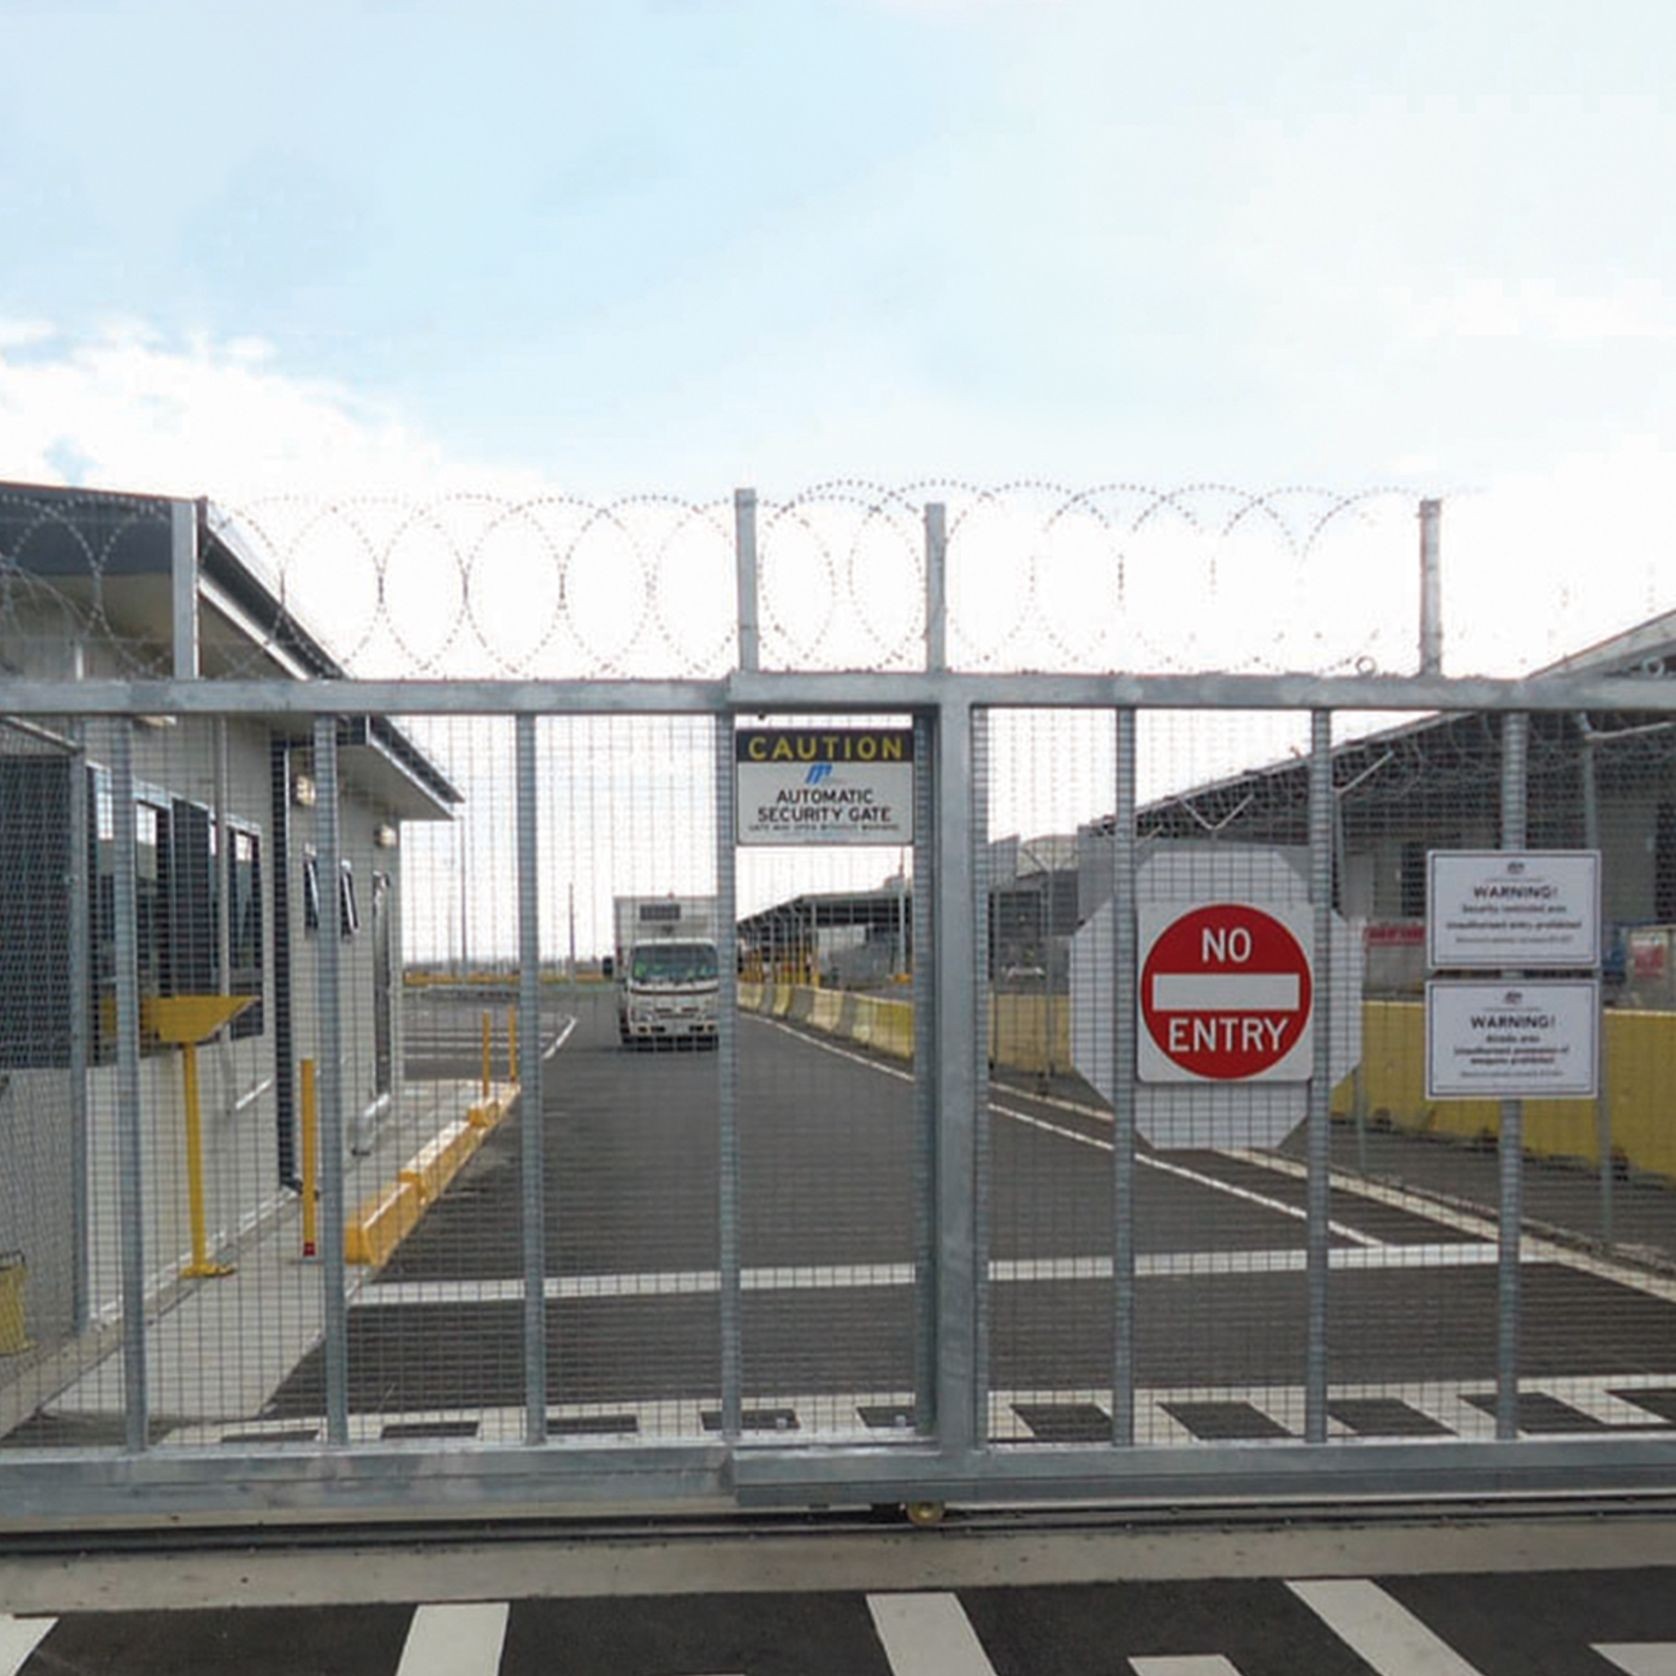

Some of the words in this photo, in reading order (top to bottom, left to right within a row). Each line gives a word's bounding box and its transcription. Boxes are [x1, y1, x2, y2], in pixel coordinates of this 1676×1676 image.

[748, 736, 903, 760] CAUTION
[776, 789, 874, 804] AUTOMATIC
[758, 807, 843, 822] SECURITY
[848, 807, 892, 822] GATE
[1202, 928, 1252, 963] NO
[1471, 1016, 1556, 1029] WARNING!
[1168, 1017, 1289, 1052] ENTRY
